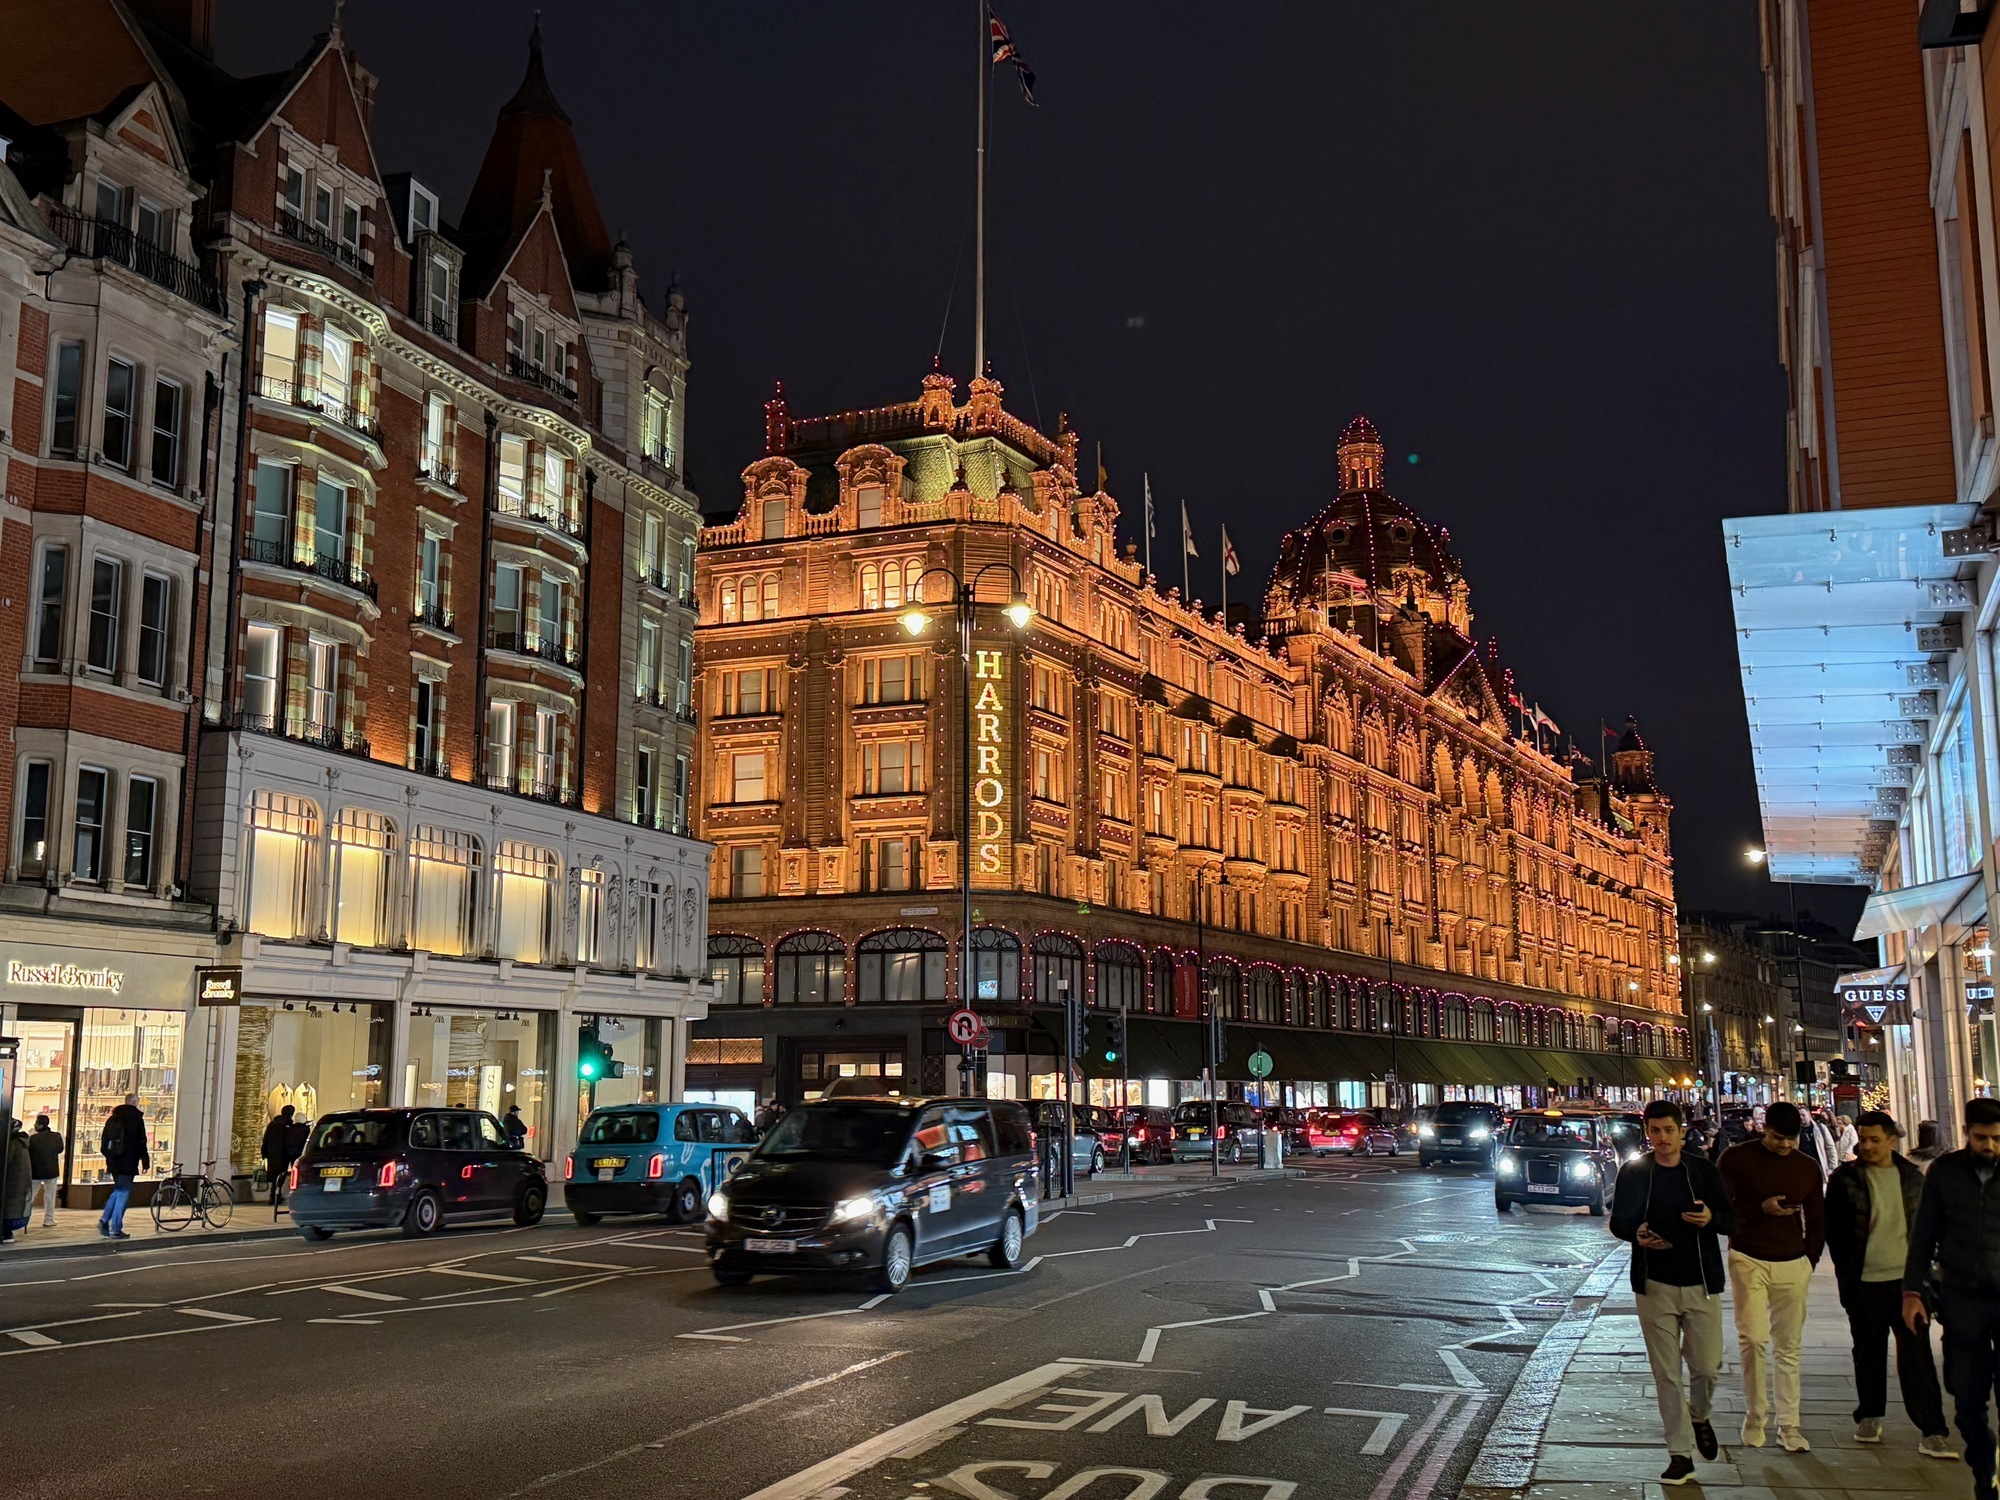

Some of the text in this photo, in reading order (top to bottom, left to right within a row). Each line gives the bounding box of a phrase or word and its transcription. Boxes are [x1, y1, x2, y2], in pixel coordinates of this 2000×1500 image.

[974, 650, 1003, 873] HARRODS
[1844, 989, 1906, 1002] GUESS
[980, 1387, 1409, 1455] LANE
